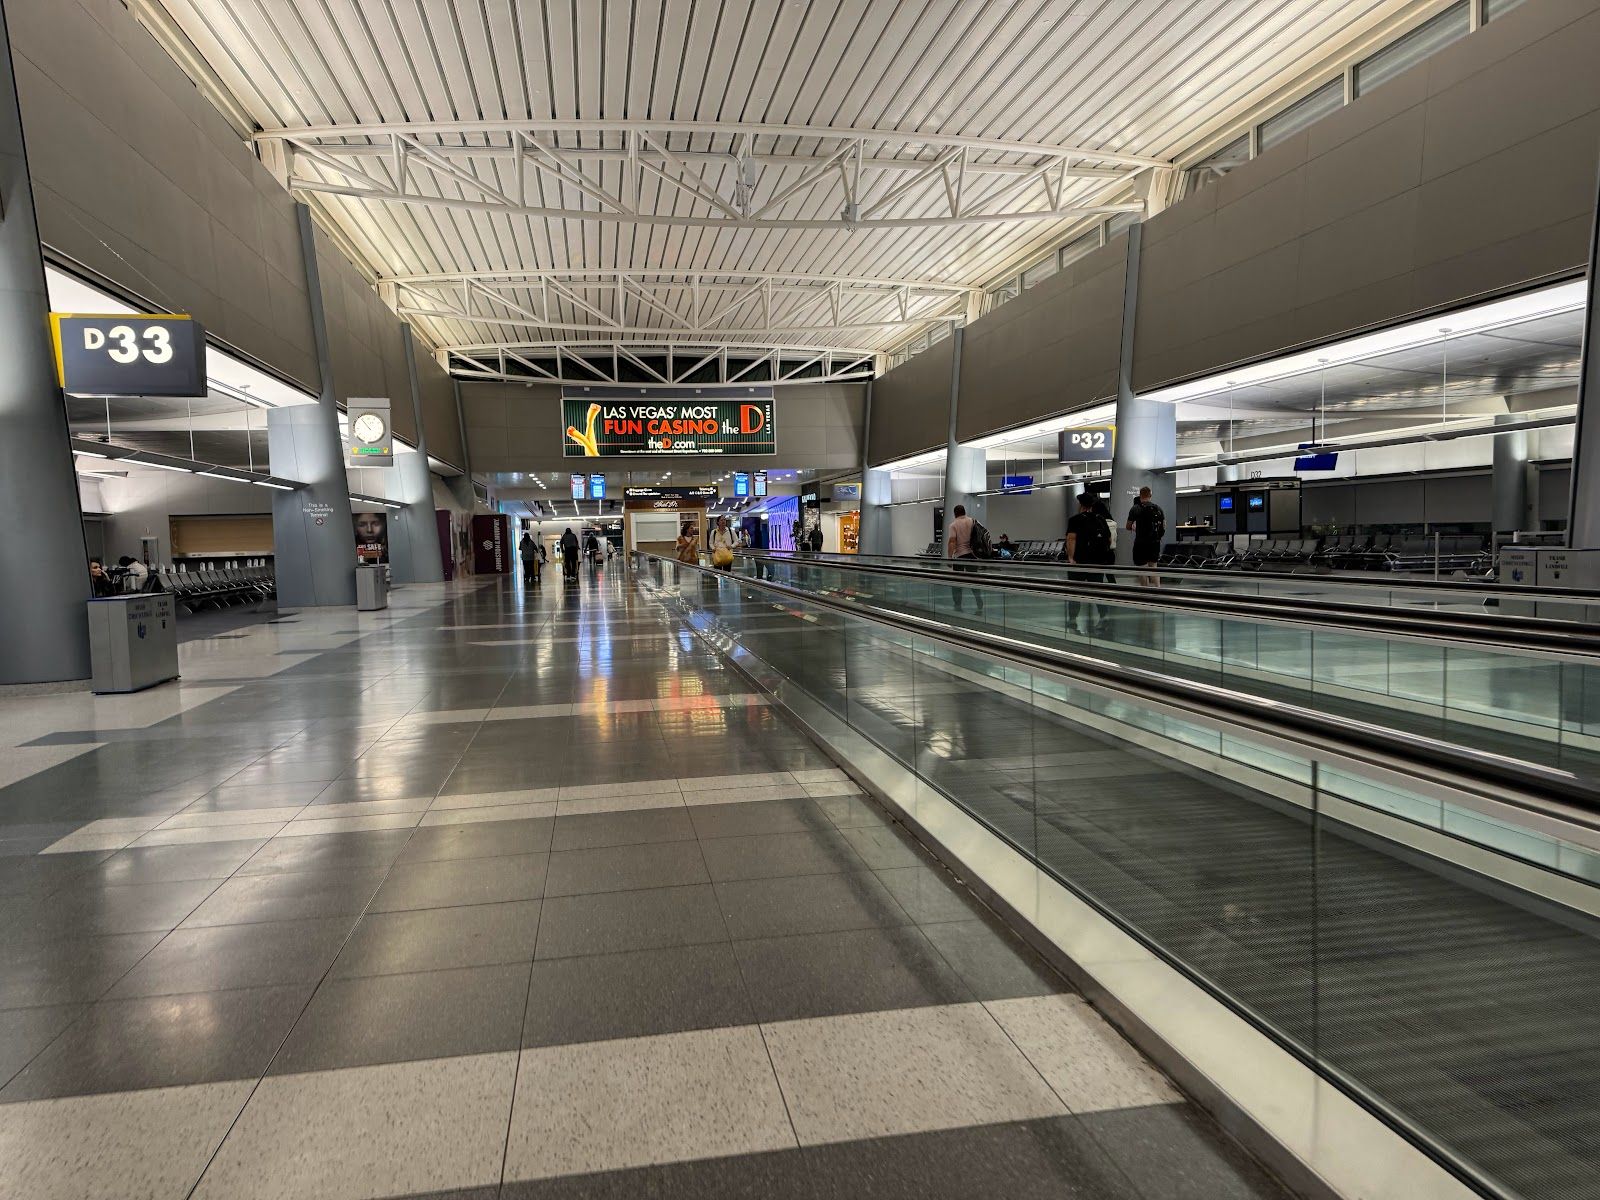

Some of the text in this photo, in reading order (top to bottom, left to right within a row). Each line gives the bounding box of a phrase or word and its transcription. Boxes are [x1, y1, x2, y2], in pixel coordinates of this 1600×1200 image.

[84, 325, 173, 364] D33
[603, 406, 718, 419] LAS VEGAS' MOST
[722, 404, 765, 435] the D
[604, 419, 719, 435] FUN CASINO
[648, 436, 695, 449] theD.com
[1072, 432, 1105, 449] D32
